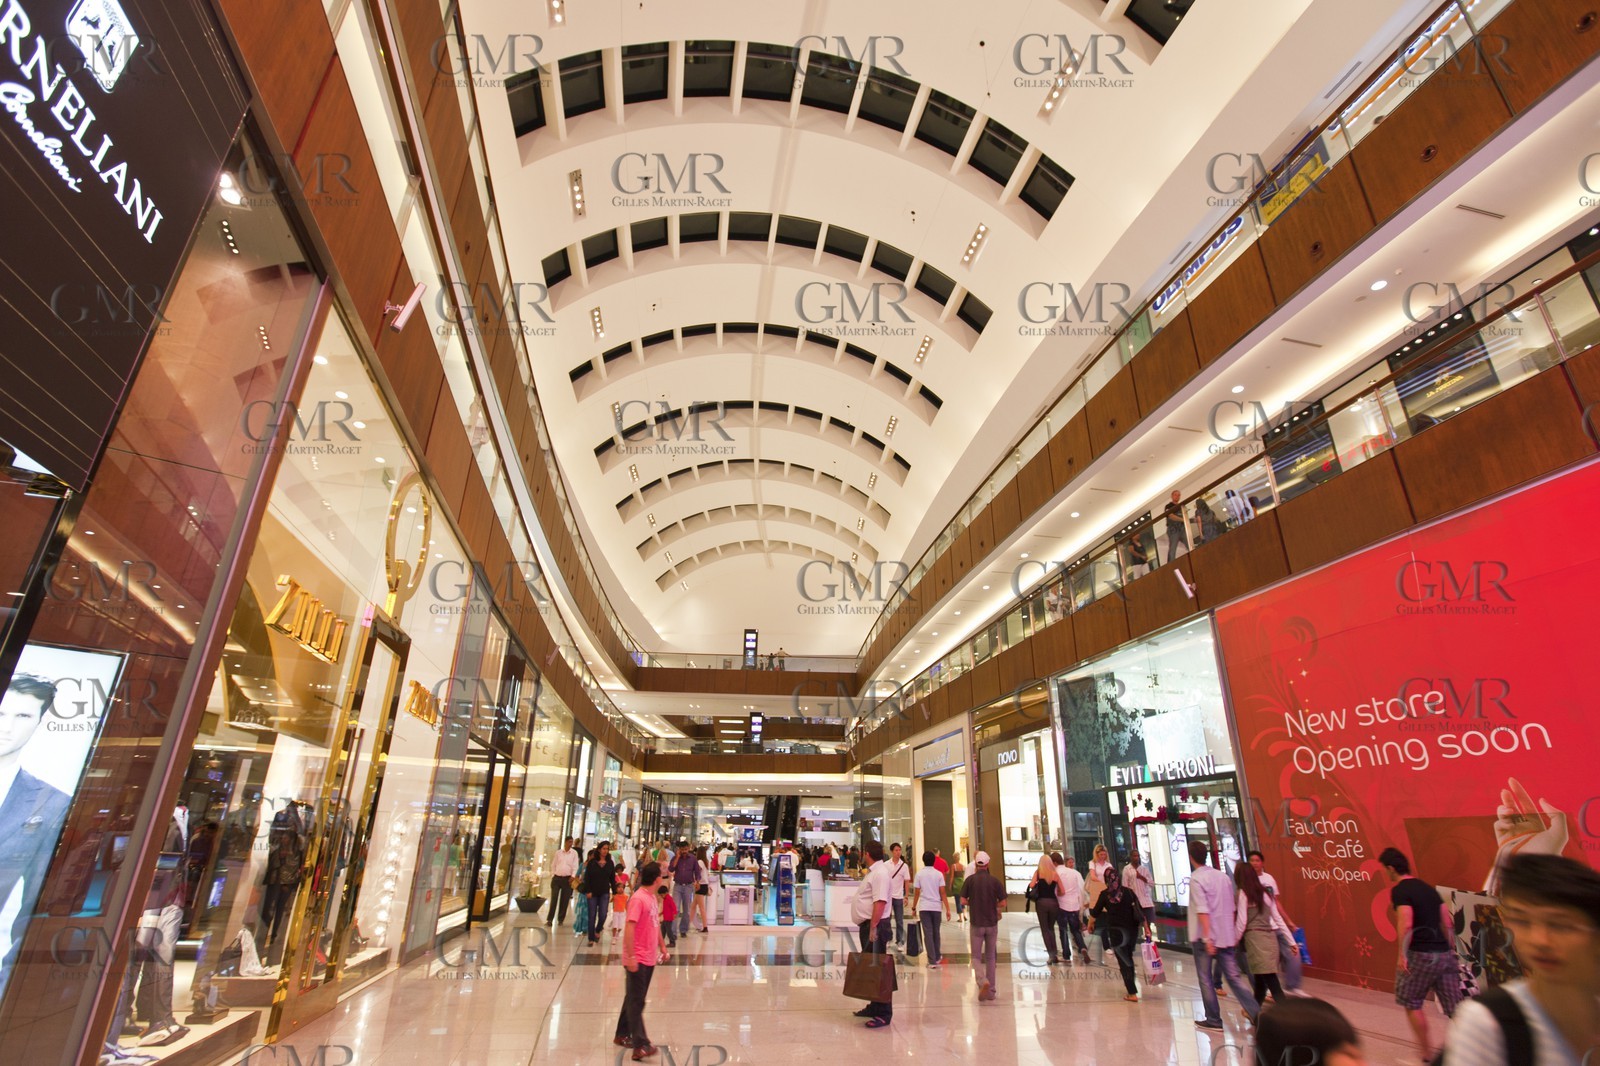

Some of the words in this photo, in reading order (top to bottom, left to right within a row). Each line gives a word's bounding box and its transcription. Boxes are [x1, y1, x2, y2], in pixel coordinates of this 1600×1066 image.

[1284, 708, 1347, 738] New
[1355, 690, 1447, 727] store
[997, 748, 1018, 766] novo
[1292, 734, 1430, 780] Opening
[1437, 722, 1553, 759] soon
[1156, 754, 1215, 782] PERONI
[1285, 816, 1359, 837] Fauchon
[1323, 839, 1364, 859] Café
[1301, 866, 1330, 881] Now
[1332, 868, 1371, 884] Open
